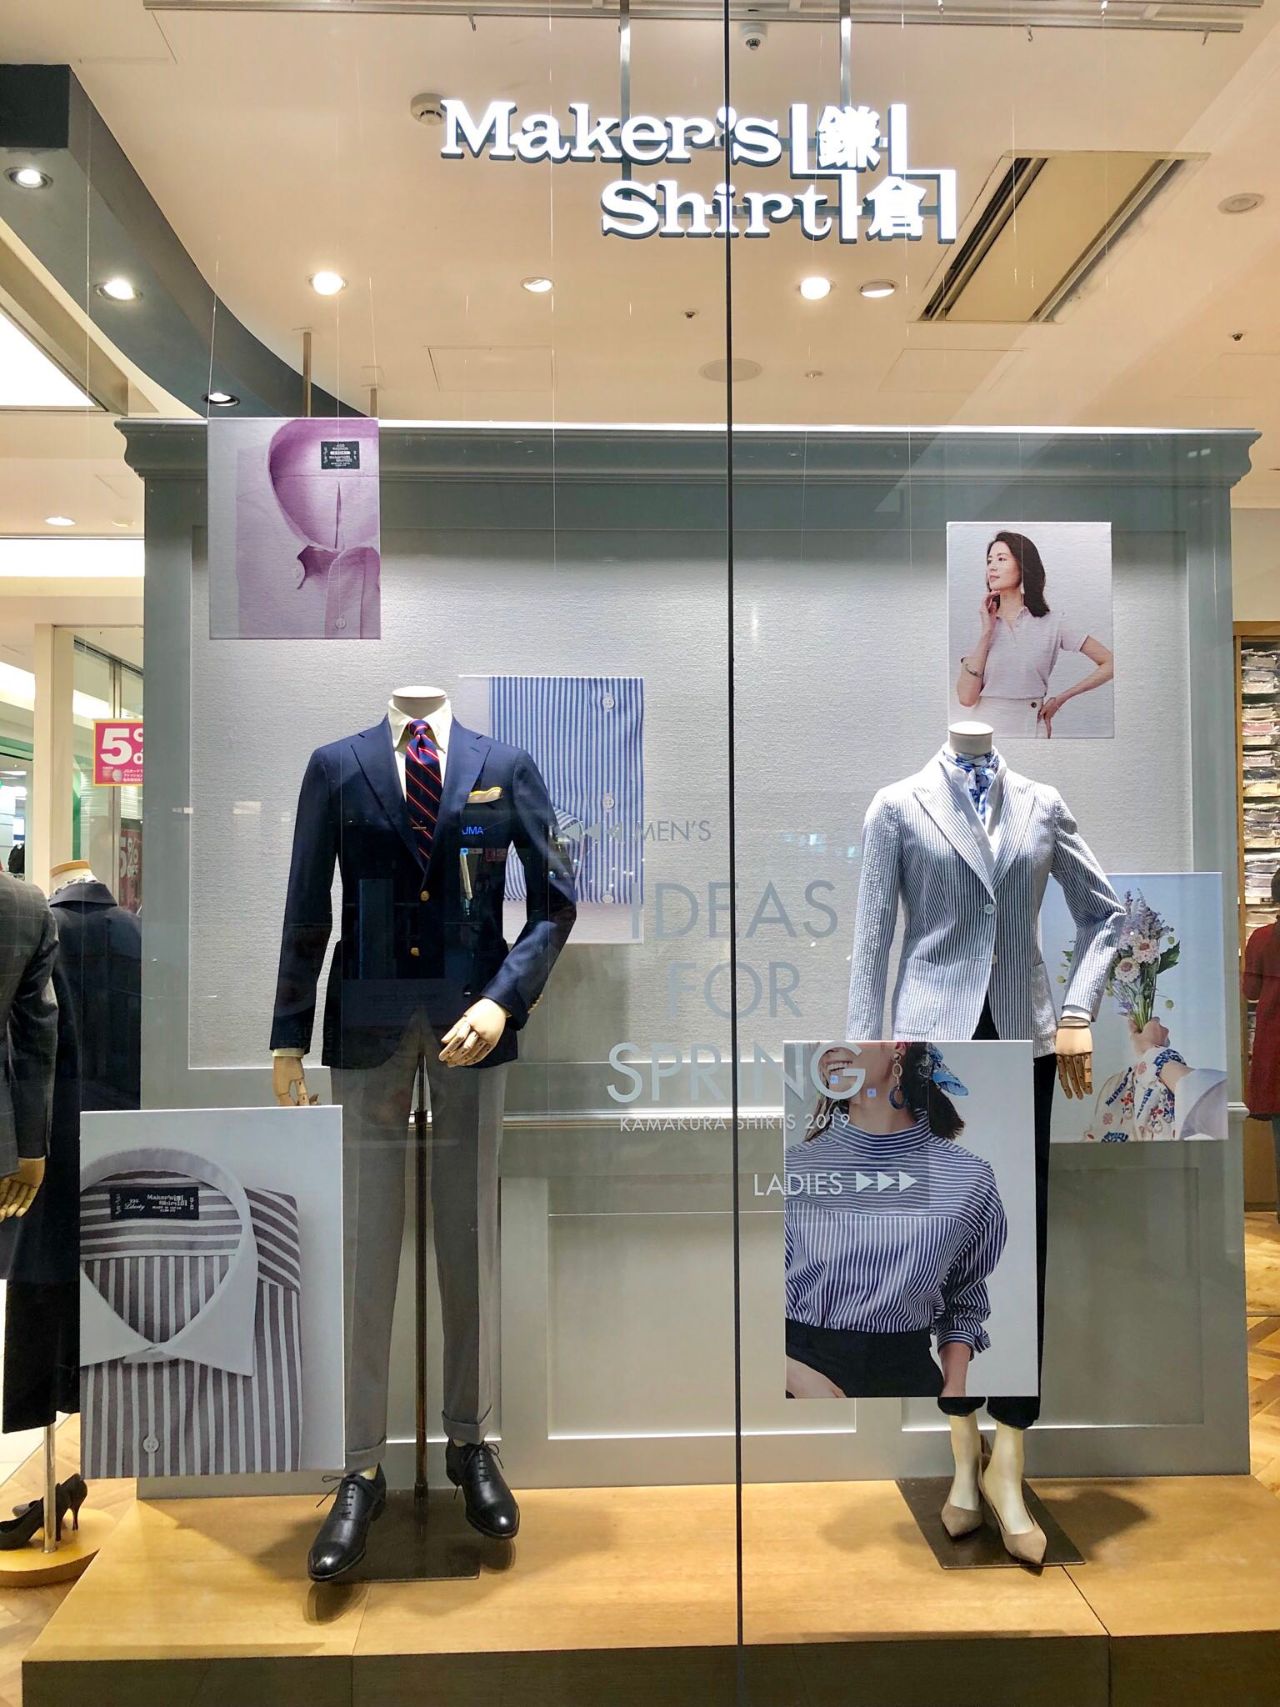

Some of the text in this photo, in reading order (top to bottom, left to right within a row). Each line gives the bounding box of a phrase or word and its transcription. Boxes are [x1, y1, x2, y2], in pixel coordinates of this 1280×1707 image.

[440, 99, 782, 166] Maker's
[601, 178, 833, 240] Shirt
[635, 820, 712, 841] MEN'S
[631, 879, 838, 938] IDEAS
[667, 960, 803, 1020] FOR
[619, 1113, 851, 1132] KAMAKURA SHIRTS 2019
[753, 1171, 844, 1197] LADIES
